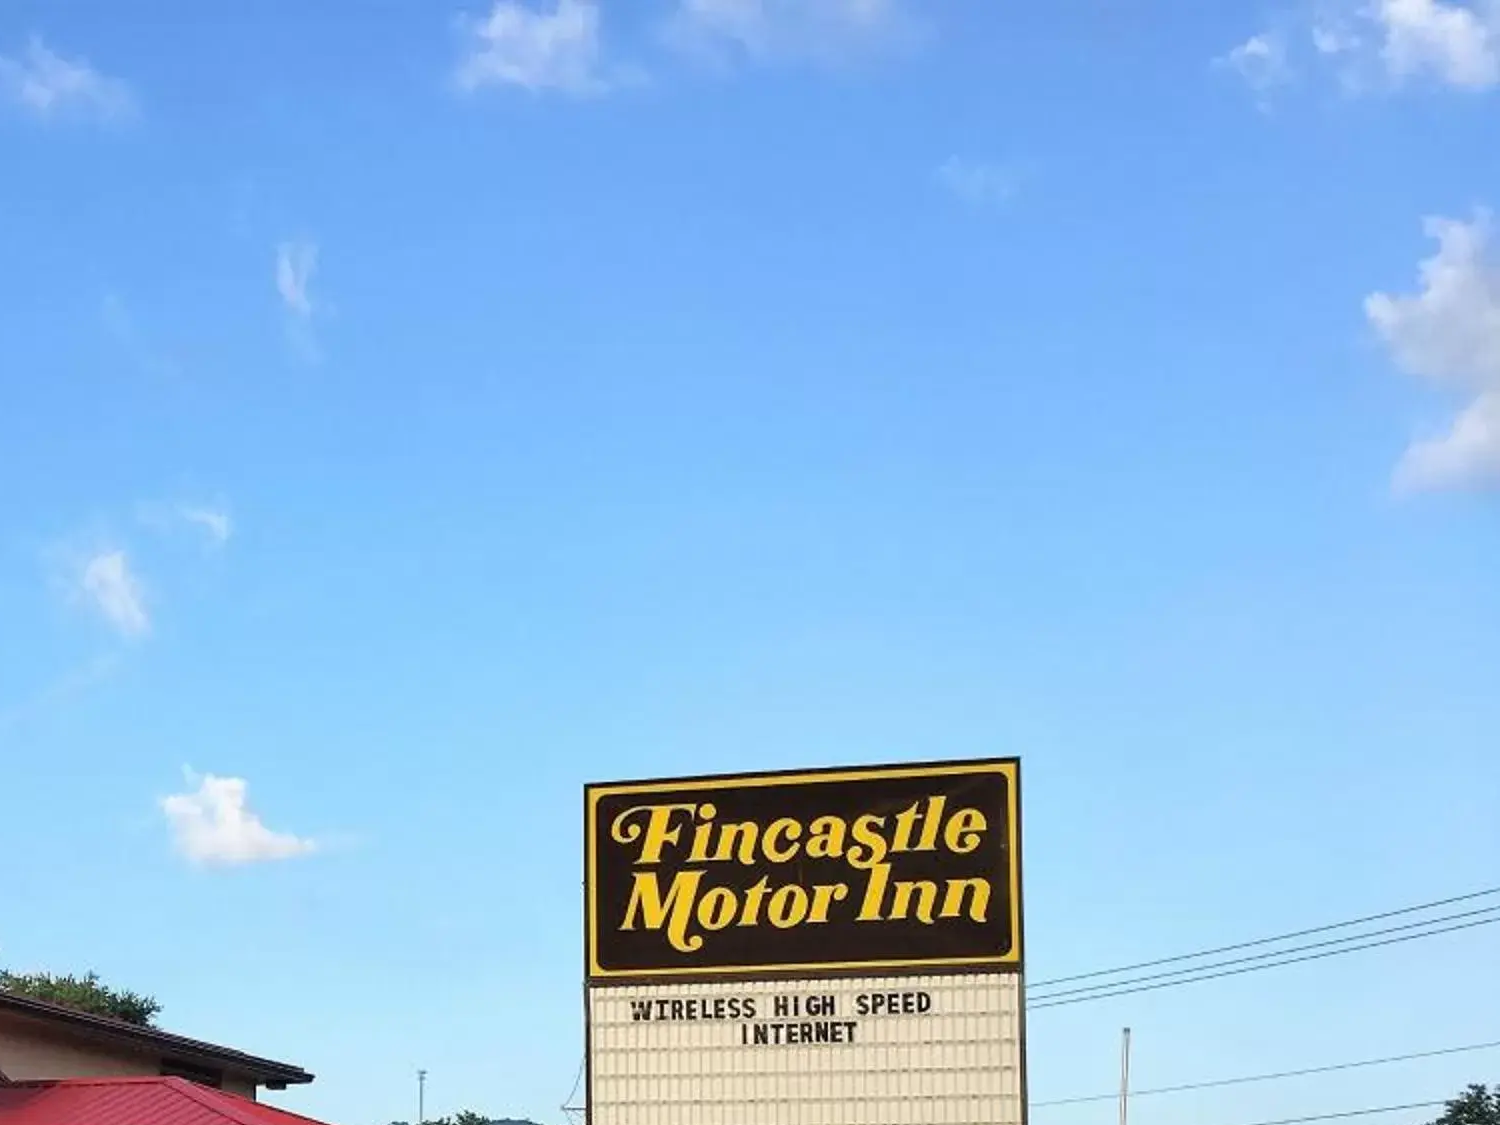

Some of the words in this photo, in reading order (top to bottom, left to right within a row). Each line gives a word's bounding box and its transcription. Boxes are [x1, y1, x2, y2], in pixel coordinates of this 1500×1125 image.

[611, 796, 988, 869] Fincastle
[618, 869, 848, 952] Motor
[856, 863, 991, 924] Inn
[630, 998, 757, 1021] WIRELESS
[773, 995, 836, 1017] HIGH
[855, 992, 932, 1016] SPEED
[741, 1021, 858, 1045] INTERNET
